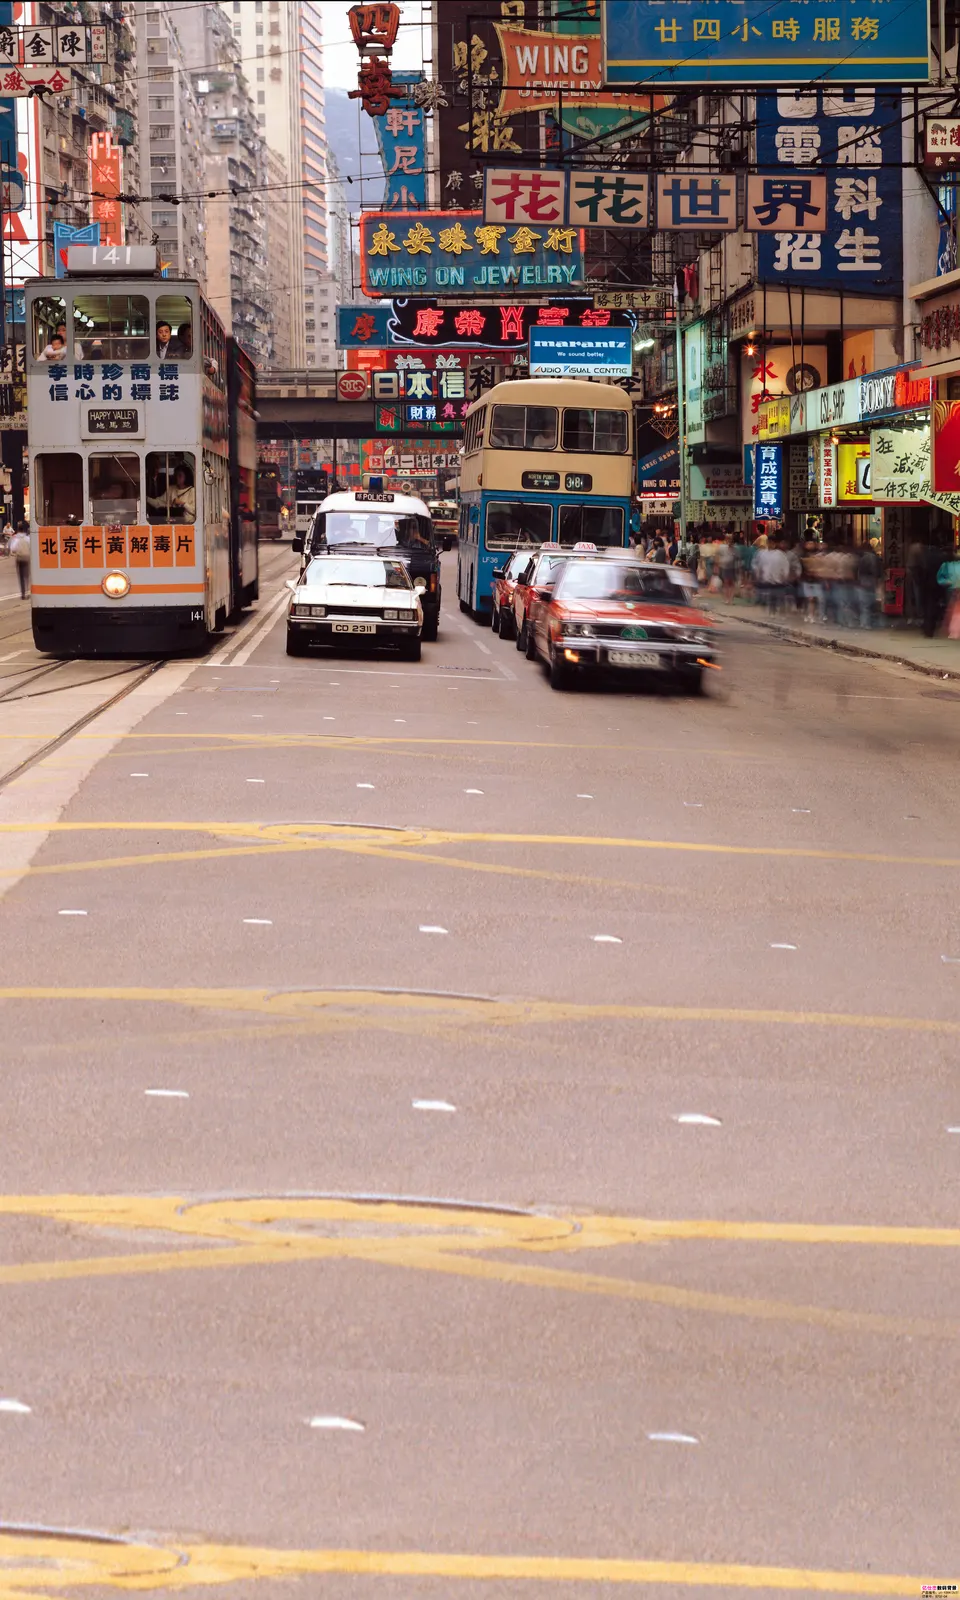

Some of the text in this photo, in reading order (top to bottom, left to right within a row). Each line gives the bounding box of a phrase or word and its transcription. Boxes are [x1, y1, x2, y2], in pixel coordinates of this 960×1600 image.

[654, 16, 880, 42] 廿四小時服務
[514, 45, 589, 75] WING
[774, 124, 882, 170] 電腦
[490, 172, 821, 227] 花花世界
[833, 176, 883, 221] 科
[367, 222, 578, 256] 永安珠寶金行
[772, 226, 882, 271] 招生
[91, 246, 132, 264] 141
[368, 264, 578, 287] WING ON JEWELRY
[533, 340, 627, 349] marantz
[48, 363, 179, 381] 李時珍商標
[49, 383, 180, 401] 信心的標誌
[373, 371, 465, 398] 日本信
[859, 374, 896, 414] SONY
[89, 410, 136, 421] HAPPY VALLEY
[642, 479, 657, 488] WING
[658, 479, 667, 488] ON
[760, 446, 778, 506] 育成英專
[362, 493, 387, 501] POLICE
[41, 535, 193, 555] 北京牛黃解毒片
[482, 556, 499, 564] LF36
[191, 611, 204, 621] 141
[335, 624, 349, 632] CD
